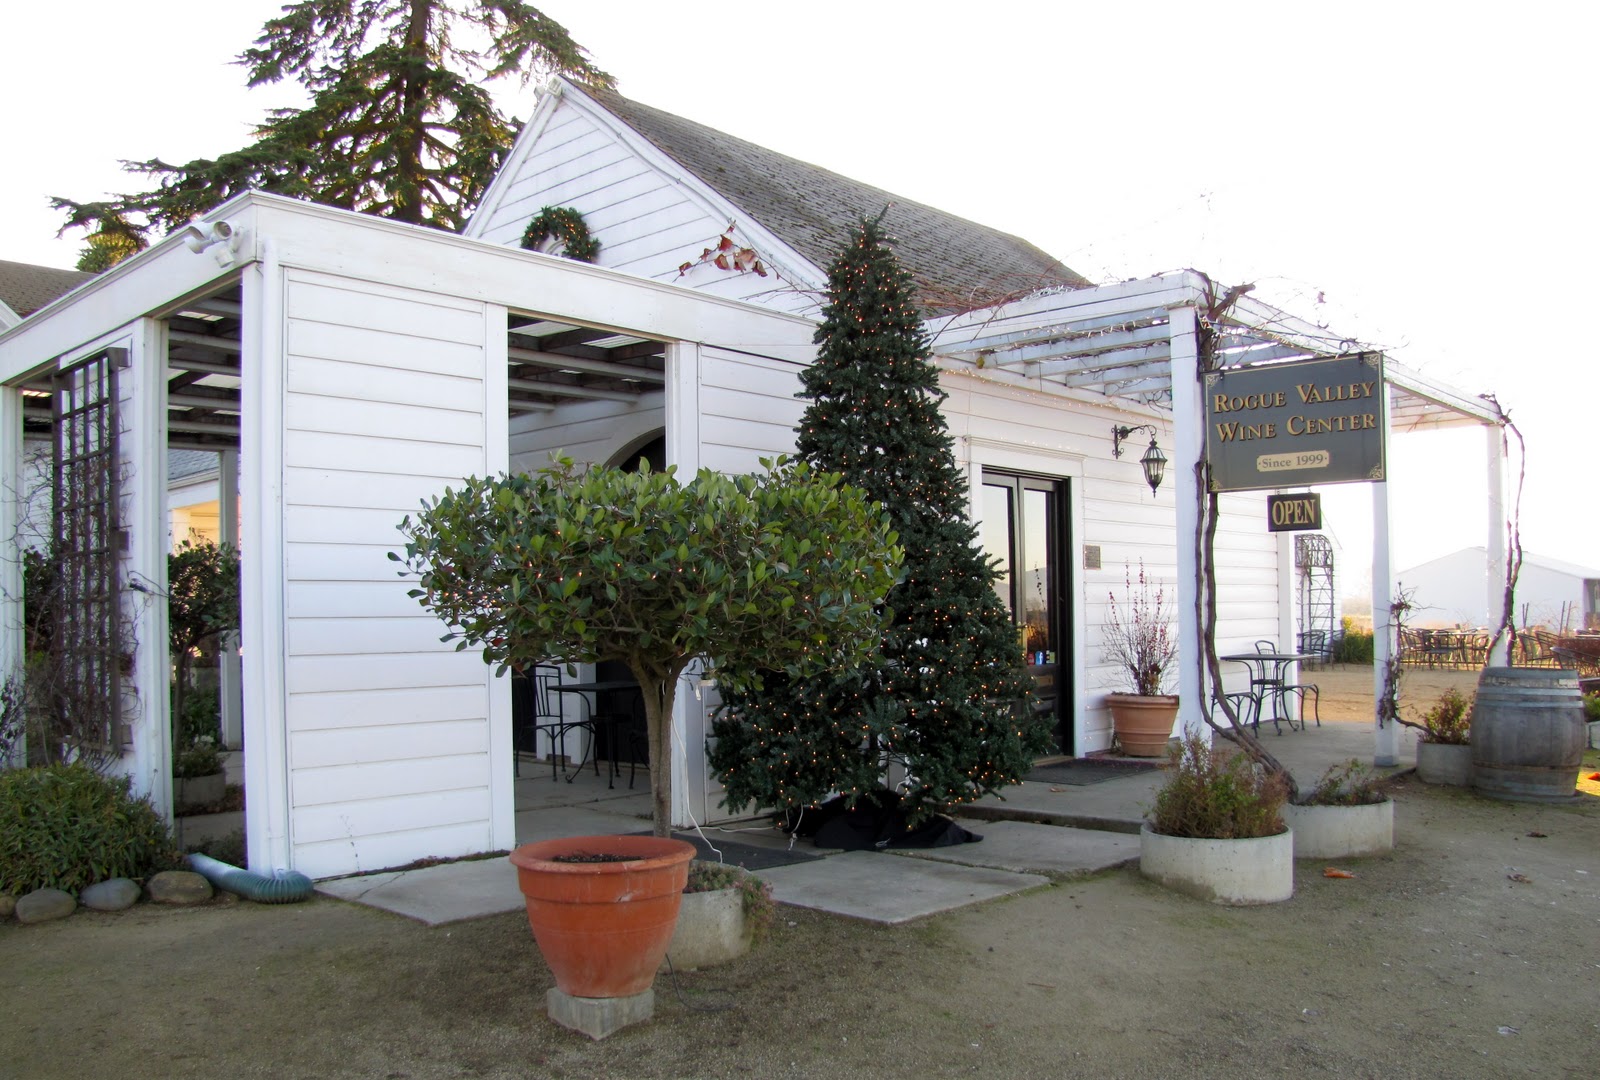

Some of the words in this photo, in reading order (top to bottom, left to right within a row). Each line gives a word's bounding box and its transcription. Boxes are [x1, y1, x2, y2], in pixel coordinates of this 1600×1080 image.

[1213, 391, 1287, 413] ROGUE
[1295, 381, 1376, 404] VALLEY
[1216, 421, 1277, 444] WINE
[1286, 414, 1377, 436] CENTER
[1261, 458, 1292, 469] Since
[1295, 454, 1324, 466] 1999
[1271, 499, 1316, 526] OPEN
